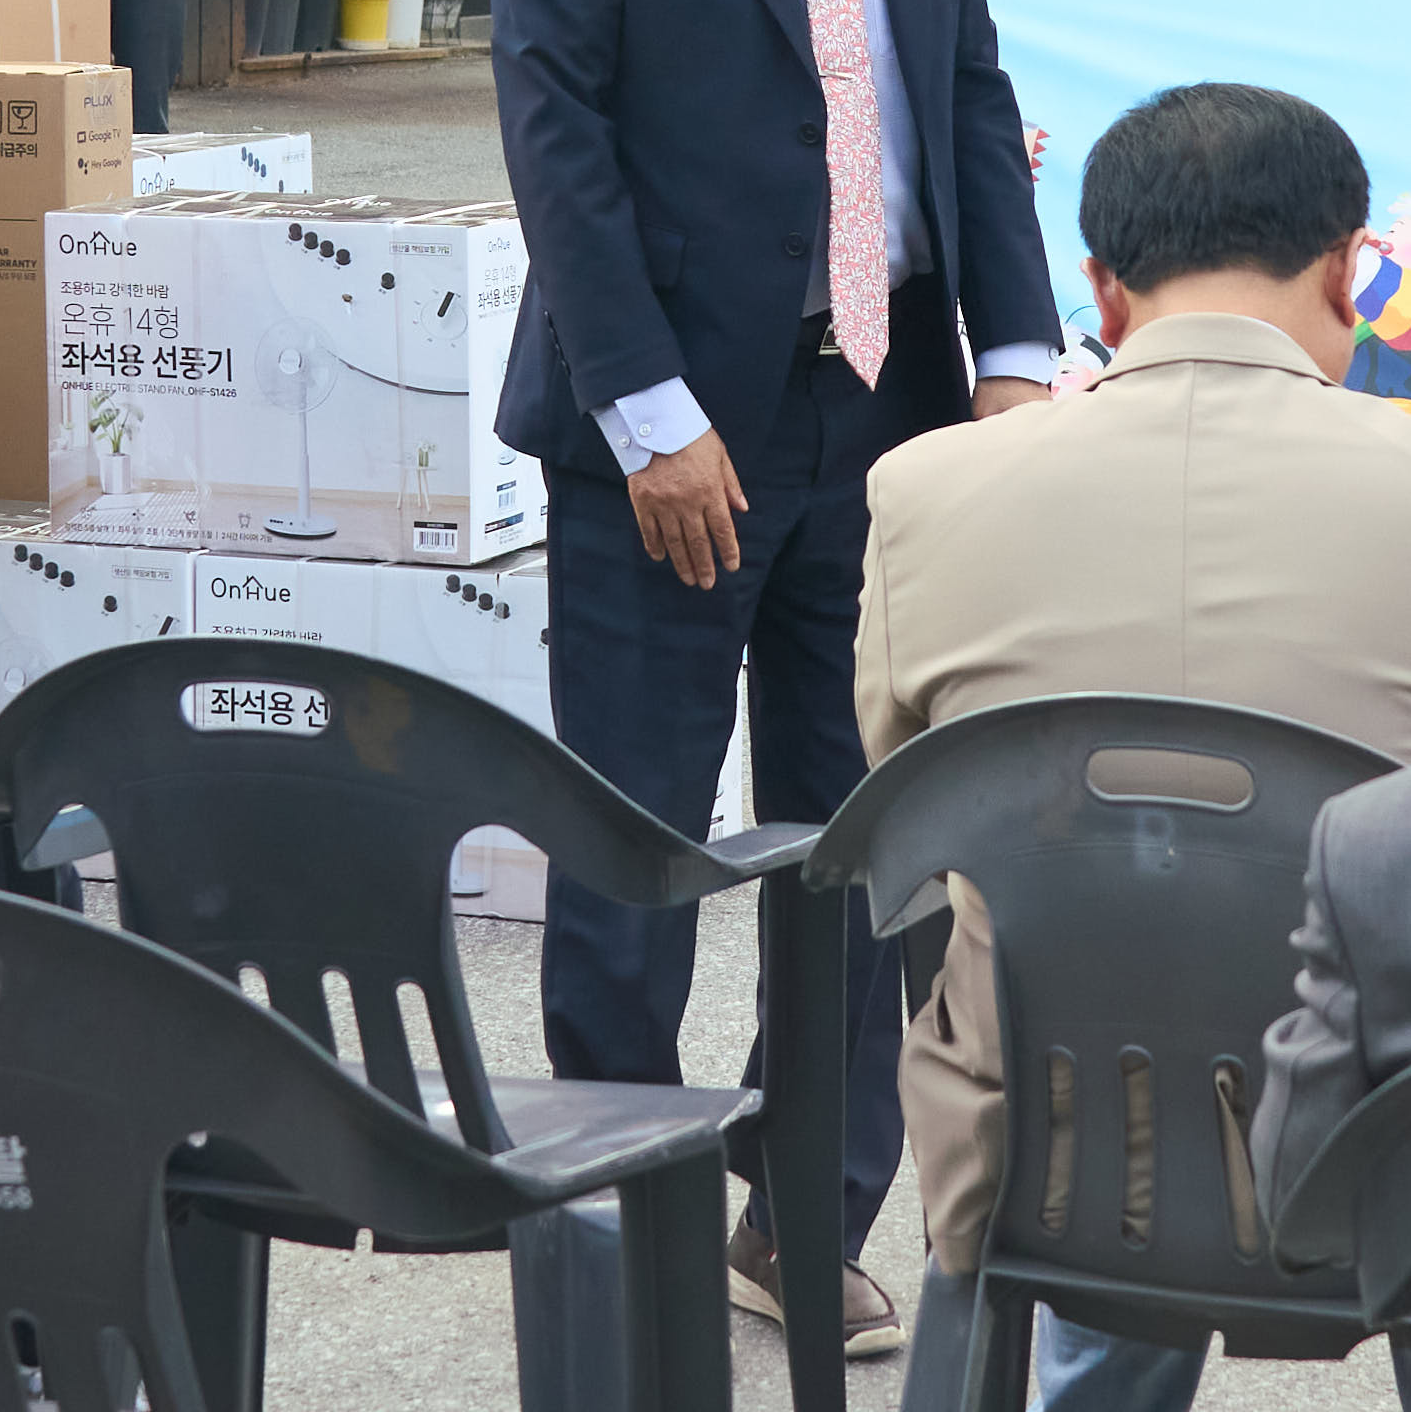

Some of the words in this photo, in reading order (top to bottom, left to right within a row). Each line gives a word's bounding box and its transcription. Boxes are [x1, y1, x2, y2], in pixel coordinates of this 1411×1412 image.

[84, 94, 113, 108] PLUX
[89, 131, 111, 143] Google
[59, 231, 138, 257] OnHue
[61, 281, 106, 296] 조용하고
[147, 284, 169, 299] 바람
[61, 303, 116, 336] 온휴
[123, 305, 179, 339] 14형
[62, 341, 144, 377] 좌석용
[152, 345, 233, 382] 선풍기
[62, 381, 93, 391] ONHUE
[138, 383, 166, 394] STAND
[211, 575, 291, 603] OnHue
[211, 688, 293, 726] 좌석용
